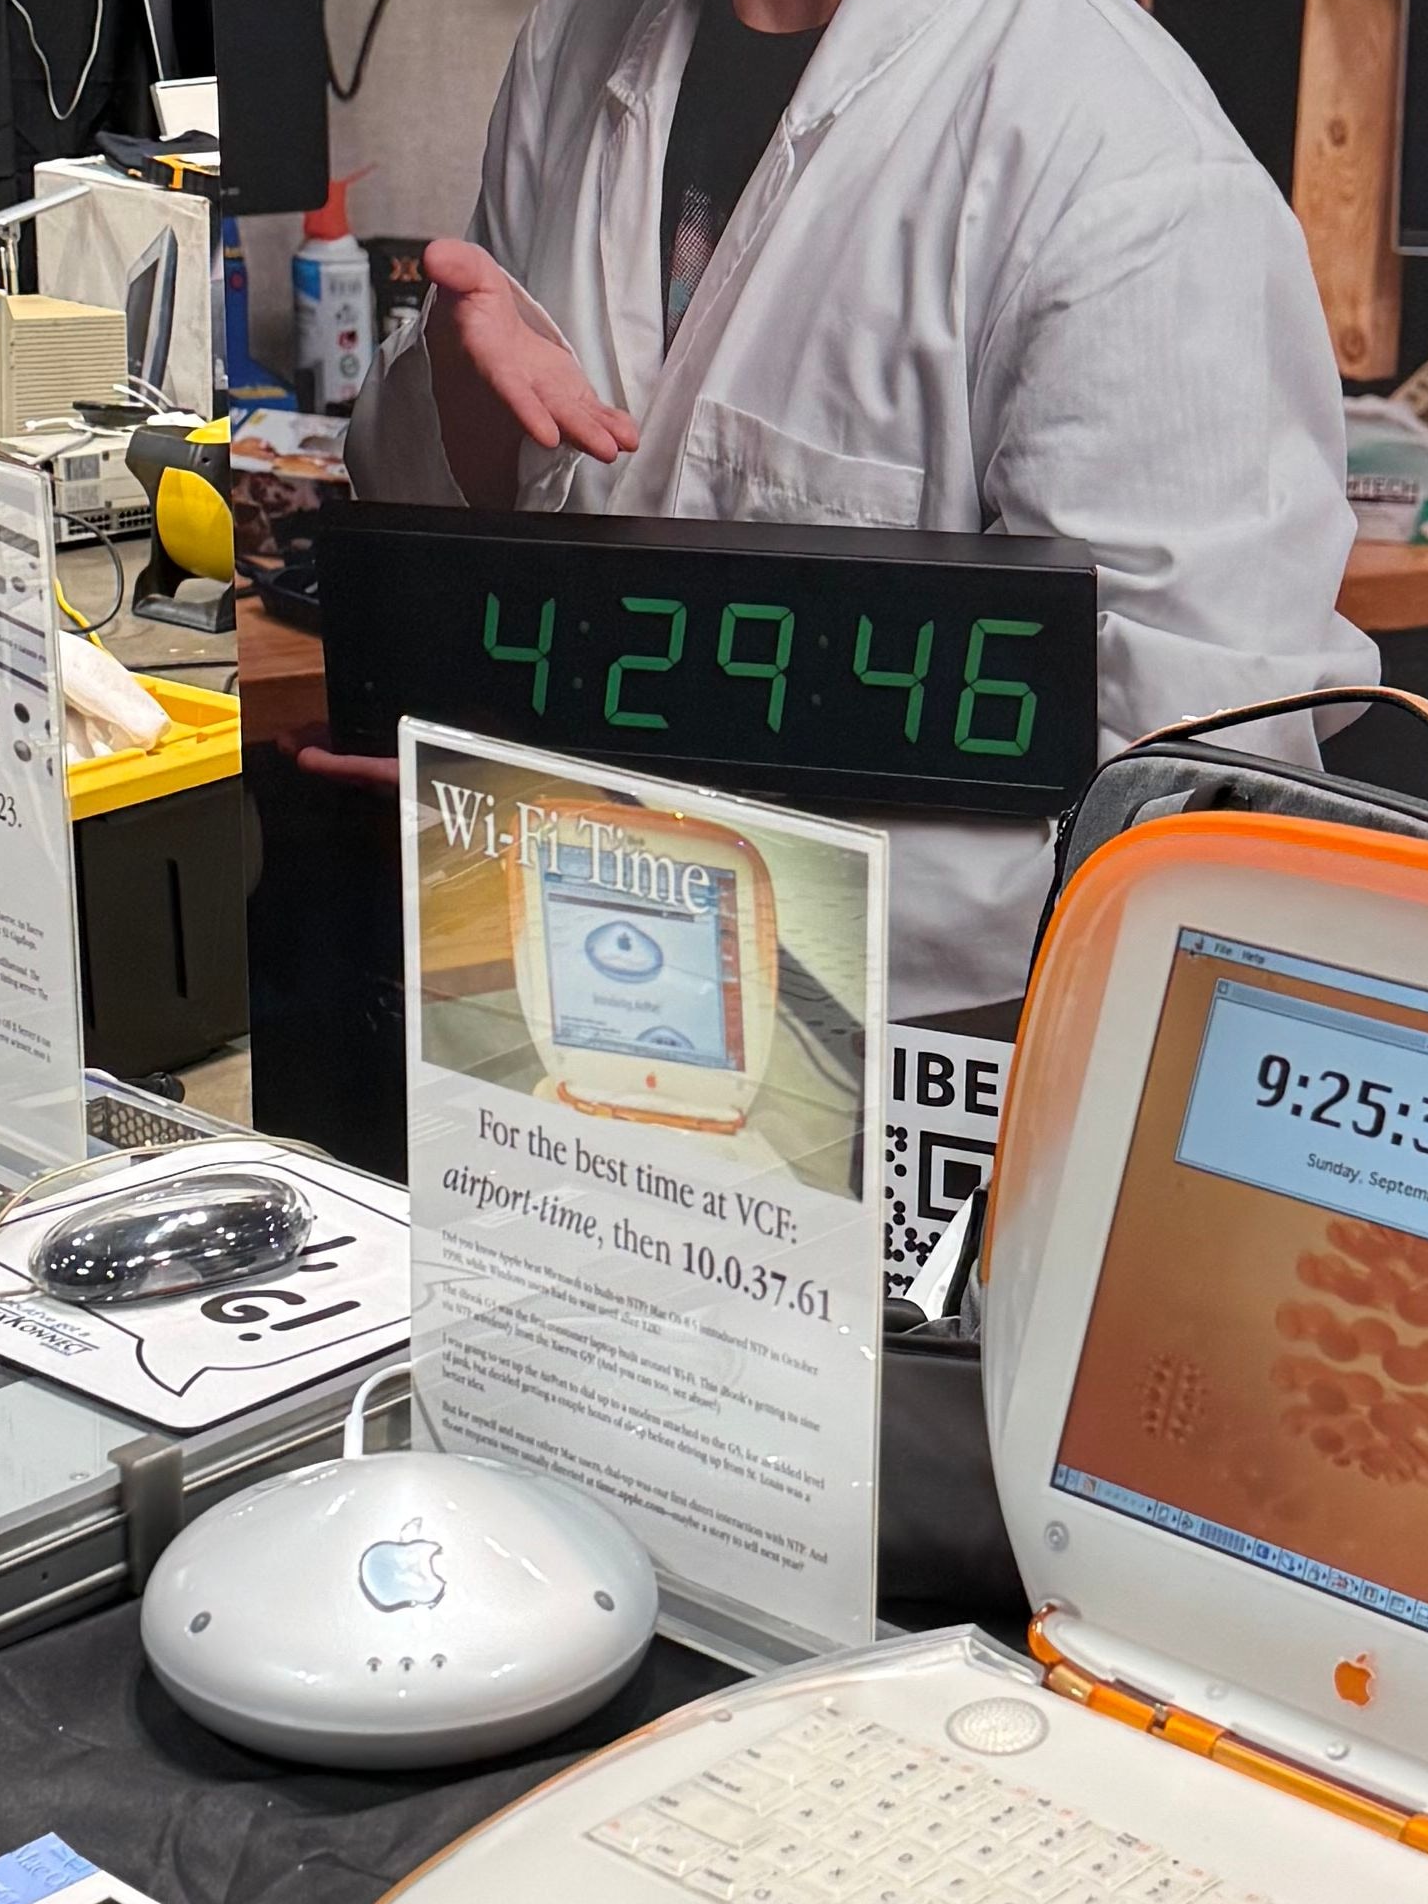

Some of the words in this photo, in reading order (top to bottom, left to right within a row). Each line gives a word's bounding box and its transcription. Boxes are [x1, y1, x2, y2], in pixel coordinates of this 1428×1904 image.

[430, 779, 564, 876] Wi-Fi
[574, 820, 712, 916] Time
[478, 1107, 522, 1151] For
[528, 1124, 567, 1166] the
[574, 1138, 628, 1187] best
[636, 1164, 695, 1208] time
[702, 1187, 728, 1221] at
[735, 1192, 799, 1245] VCF:
[1306, 1152, 1364, 1185] Sunday,
[442, 1164, 604, 1248] airport-time,
[613, 1217, 673, 1267] then
[681, 1241, 832, 1323] 10.0.37.61
[442, 1365, 465, 1384] better
[488, 1366, 520, 1389] decided
[521, 1379, 549, 1403] getting
[558, 1393, 584, 1417] couple
[587, 1405, 611, 1424] hours
[647, 1428, 674, 1449] before
[677, 1439, 707, 1465] driving
[723, 1457, 744, 1476] from
[760, 1471, 783, 1491] Louis
[786, 1485, 802, 1499] was
[442, 1398, 455, 1415] But
[471, 1410, 496, 1434] myself
[498, 1421, 513, 1438] and
[515, 1428, 534, 1446] most
[536, 1436, 558, 1456] other
[560, 1446, 576, 1463] Mac
[636, 1479, 651, 1493] was
[653, 1486, 668, 1500] our
[670, 1489, 686, 1507] first
[689, 1497, 713, 1518] direct
[715, 1508, 763, 1538] interaction
[765, 1527, 784, 1546] with
[809, 1545, 827, 1563] And
[500, 1442, 518, 1457] were
[521, 1447, 549, 1472] usually
[709, 1522, 730, 1546] story
[744, 1536, 758, 1554] tell
[760, 1543, 779, 1562] next
